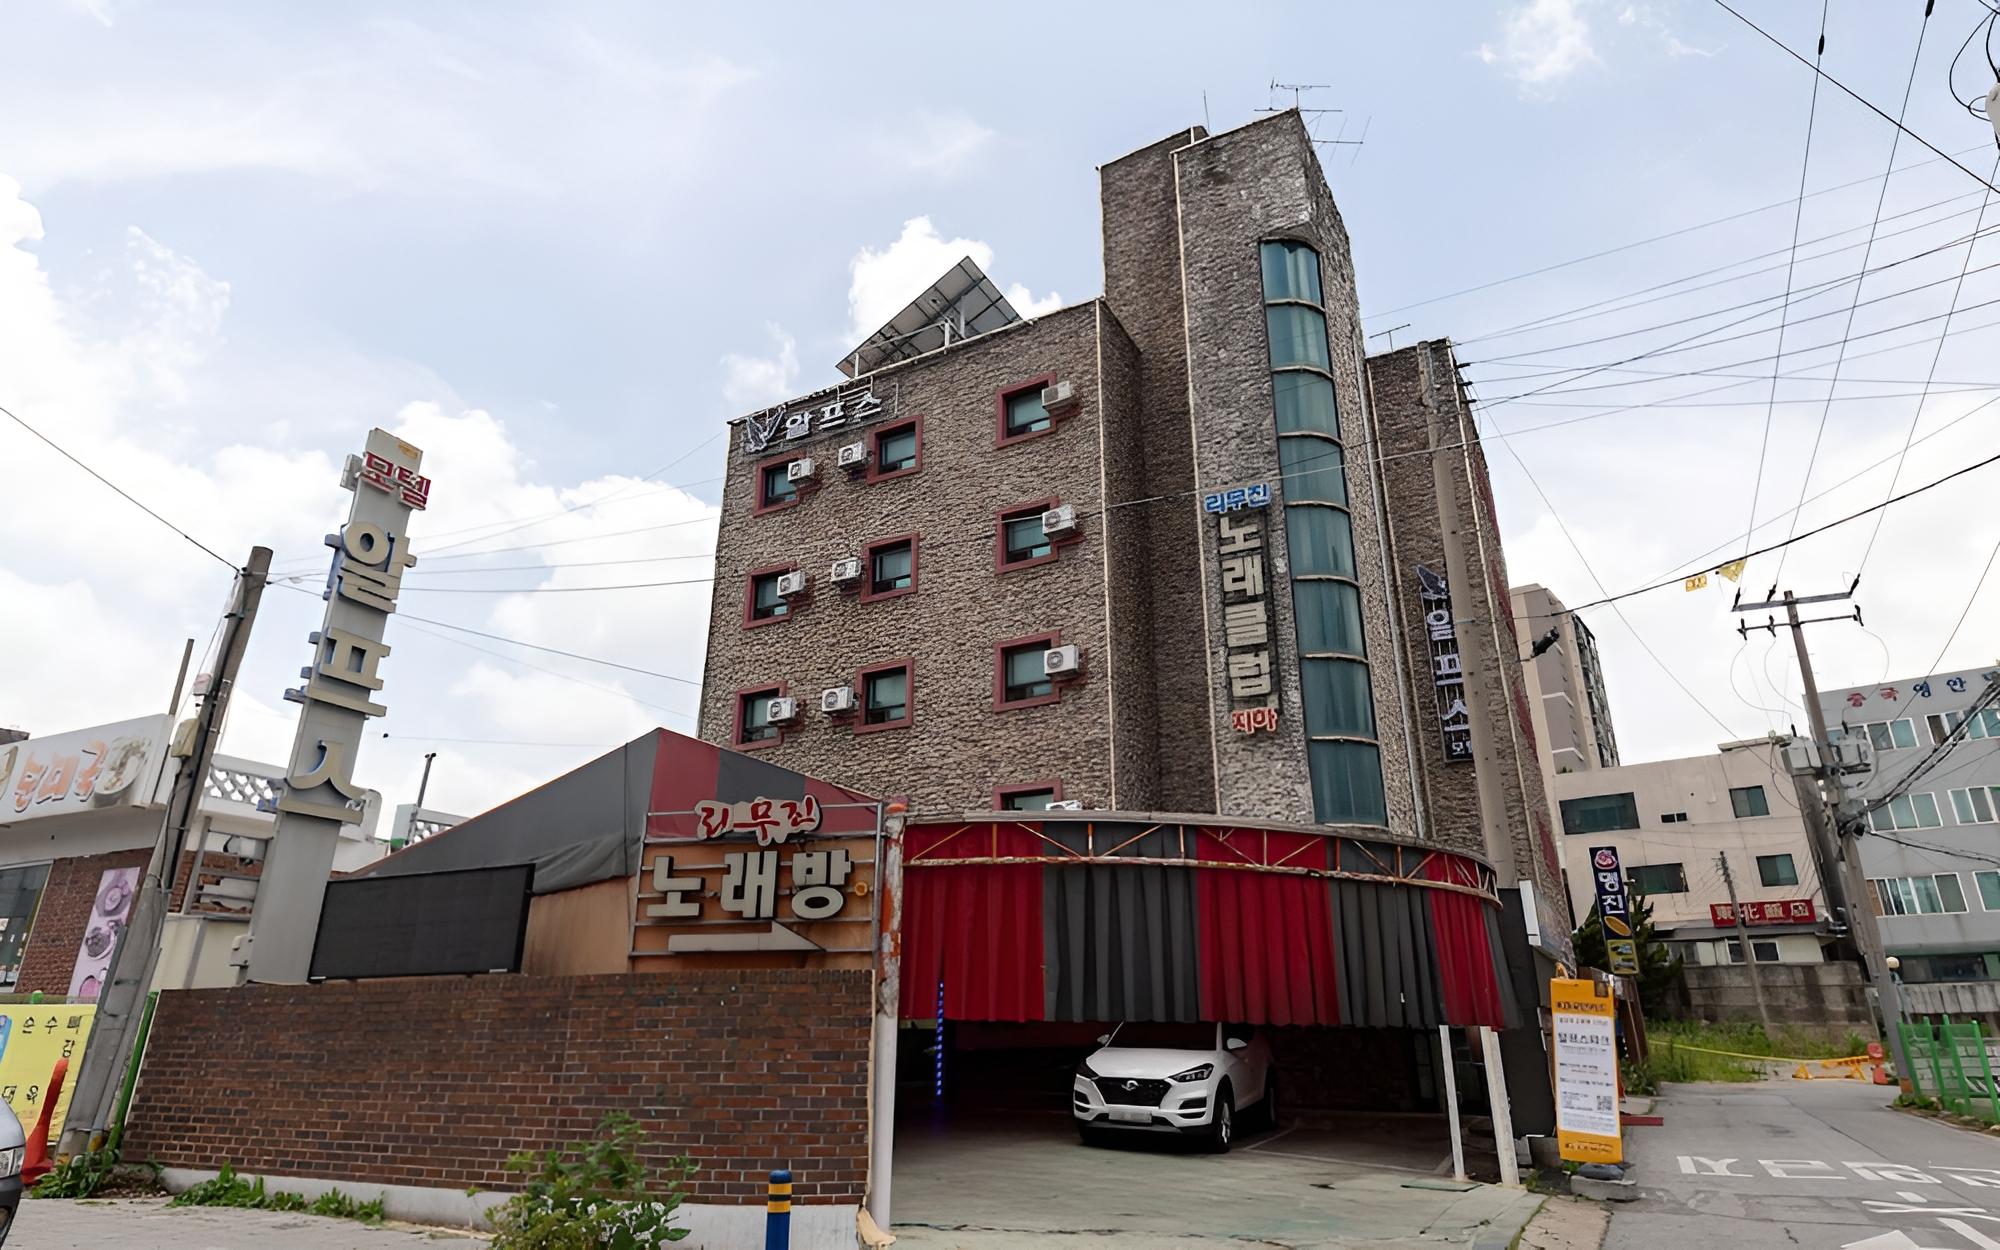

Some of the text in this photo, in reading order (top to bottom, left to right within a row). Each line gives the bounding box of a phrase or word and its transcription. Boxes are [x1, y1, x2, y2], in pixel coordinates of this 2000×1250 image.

[364, 451, 431, 511] 모텔
[1205, 483, 1270, 513] 리무진
[277, 521, 417, 827] 알프스
[698, 797, 818, 841] 리무진
[647, 850, 850, 919] 노래방
